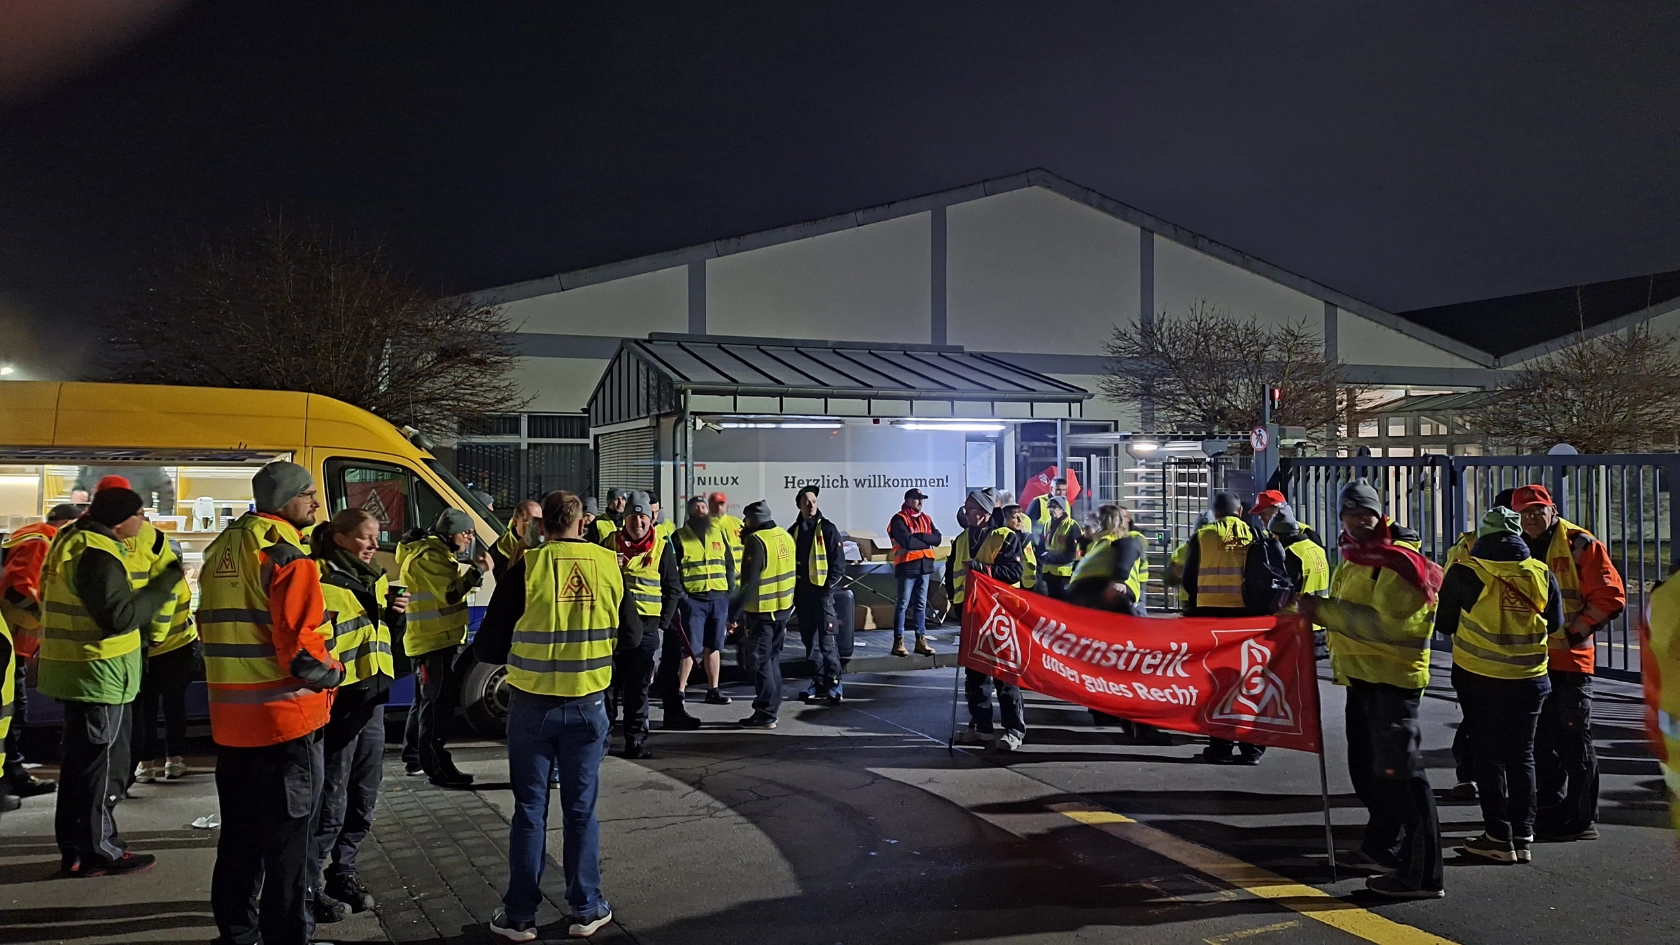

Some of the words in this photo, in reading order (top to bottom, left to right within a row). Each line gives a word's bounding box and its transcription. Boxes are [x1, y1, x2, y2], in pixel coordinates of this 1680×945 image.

[693, 476, 740, 486] NILUX
[784, 475, 849, 489] Herzlich
[853, 475, 949, 488] willkommen!
[1032, 616, 1194, 678] Warnstreik
[1042, 653, 1081, 684] unser
[1081, 673, 1134, 699] gutes
[1131, 681, 1199, 706] Recht
